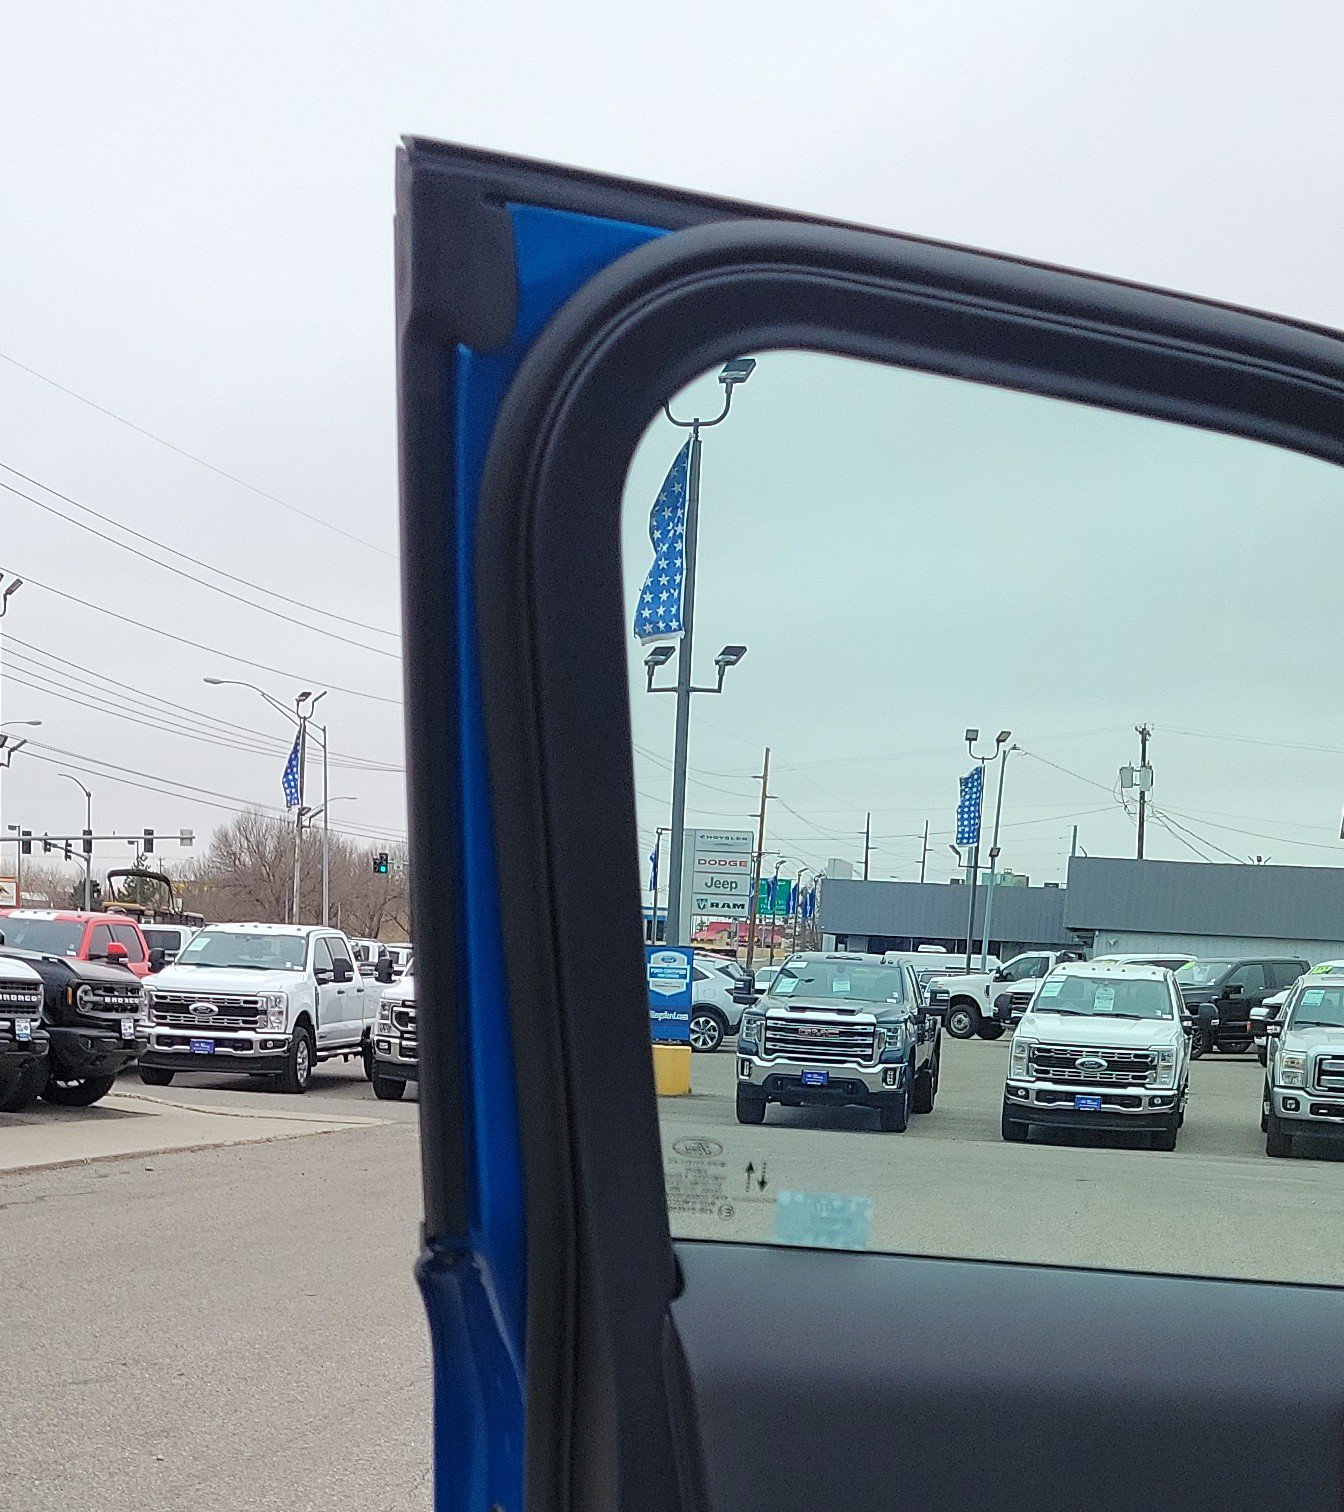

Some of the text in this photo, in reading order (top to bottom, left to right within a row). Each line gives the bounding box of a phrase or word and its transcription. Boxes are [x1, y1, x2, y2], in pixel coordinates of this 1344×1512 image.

[697, 858, 748, 868] DODGE
[704, 876, 739, 892] Jeep
[709, 901, 746, 910] RAM
